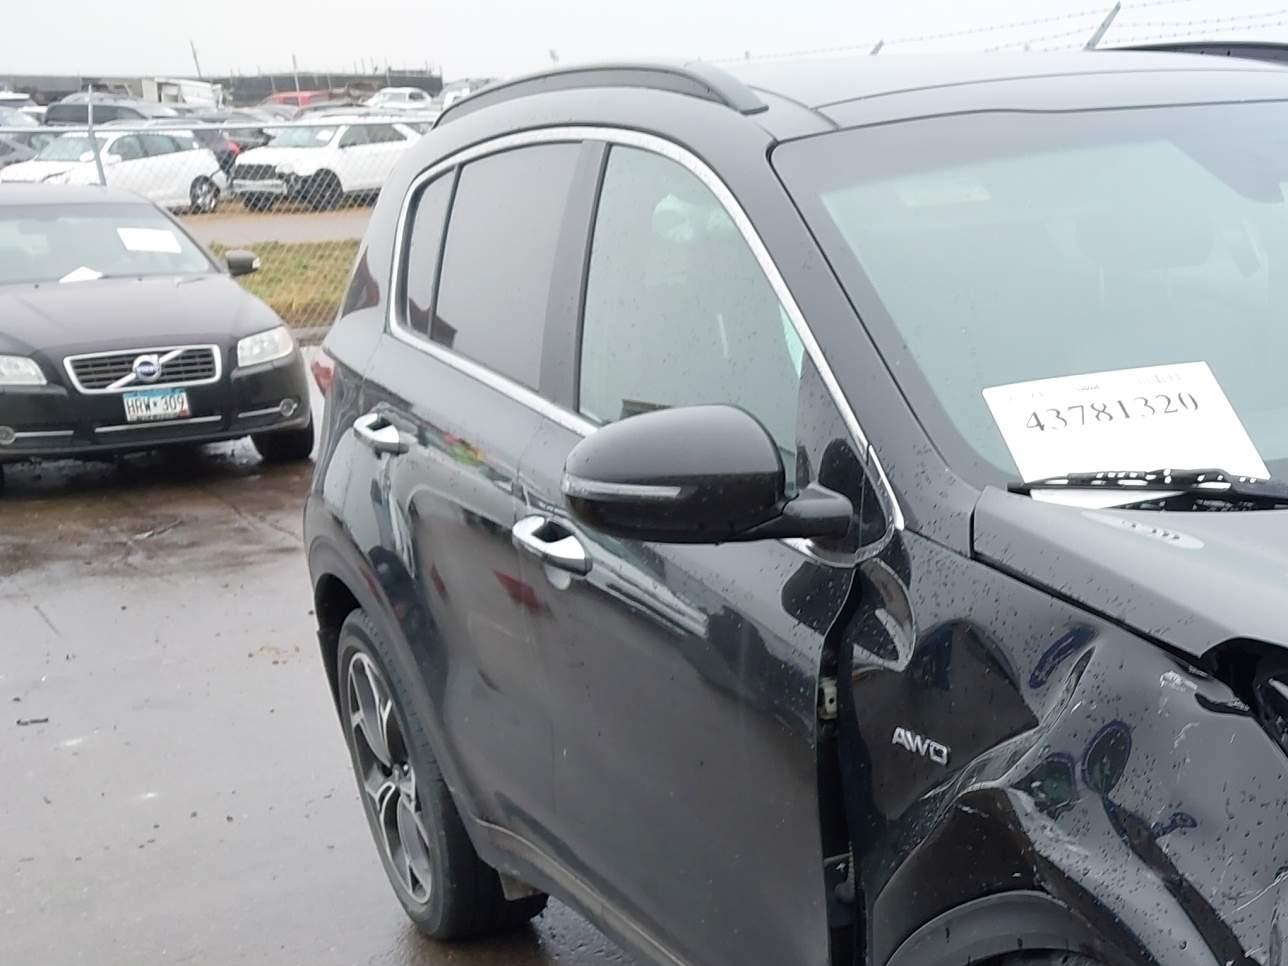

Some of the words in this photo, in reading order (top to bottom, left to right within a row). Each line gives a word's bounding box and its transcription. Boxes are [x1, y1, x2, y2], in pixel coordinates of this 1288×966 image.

[126, 396, 152, 416] HRW
[160, 392, 186, 413] 309
[1025, 391, 1199, 432] 43781320
